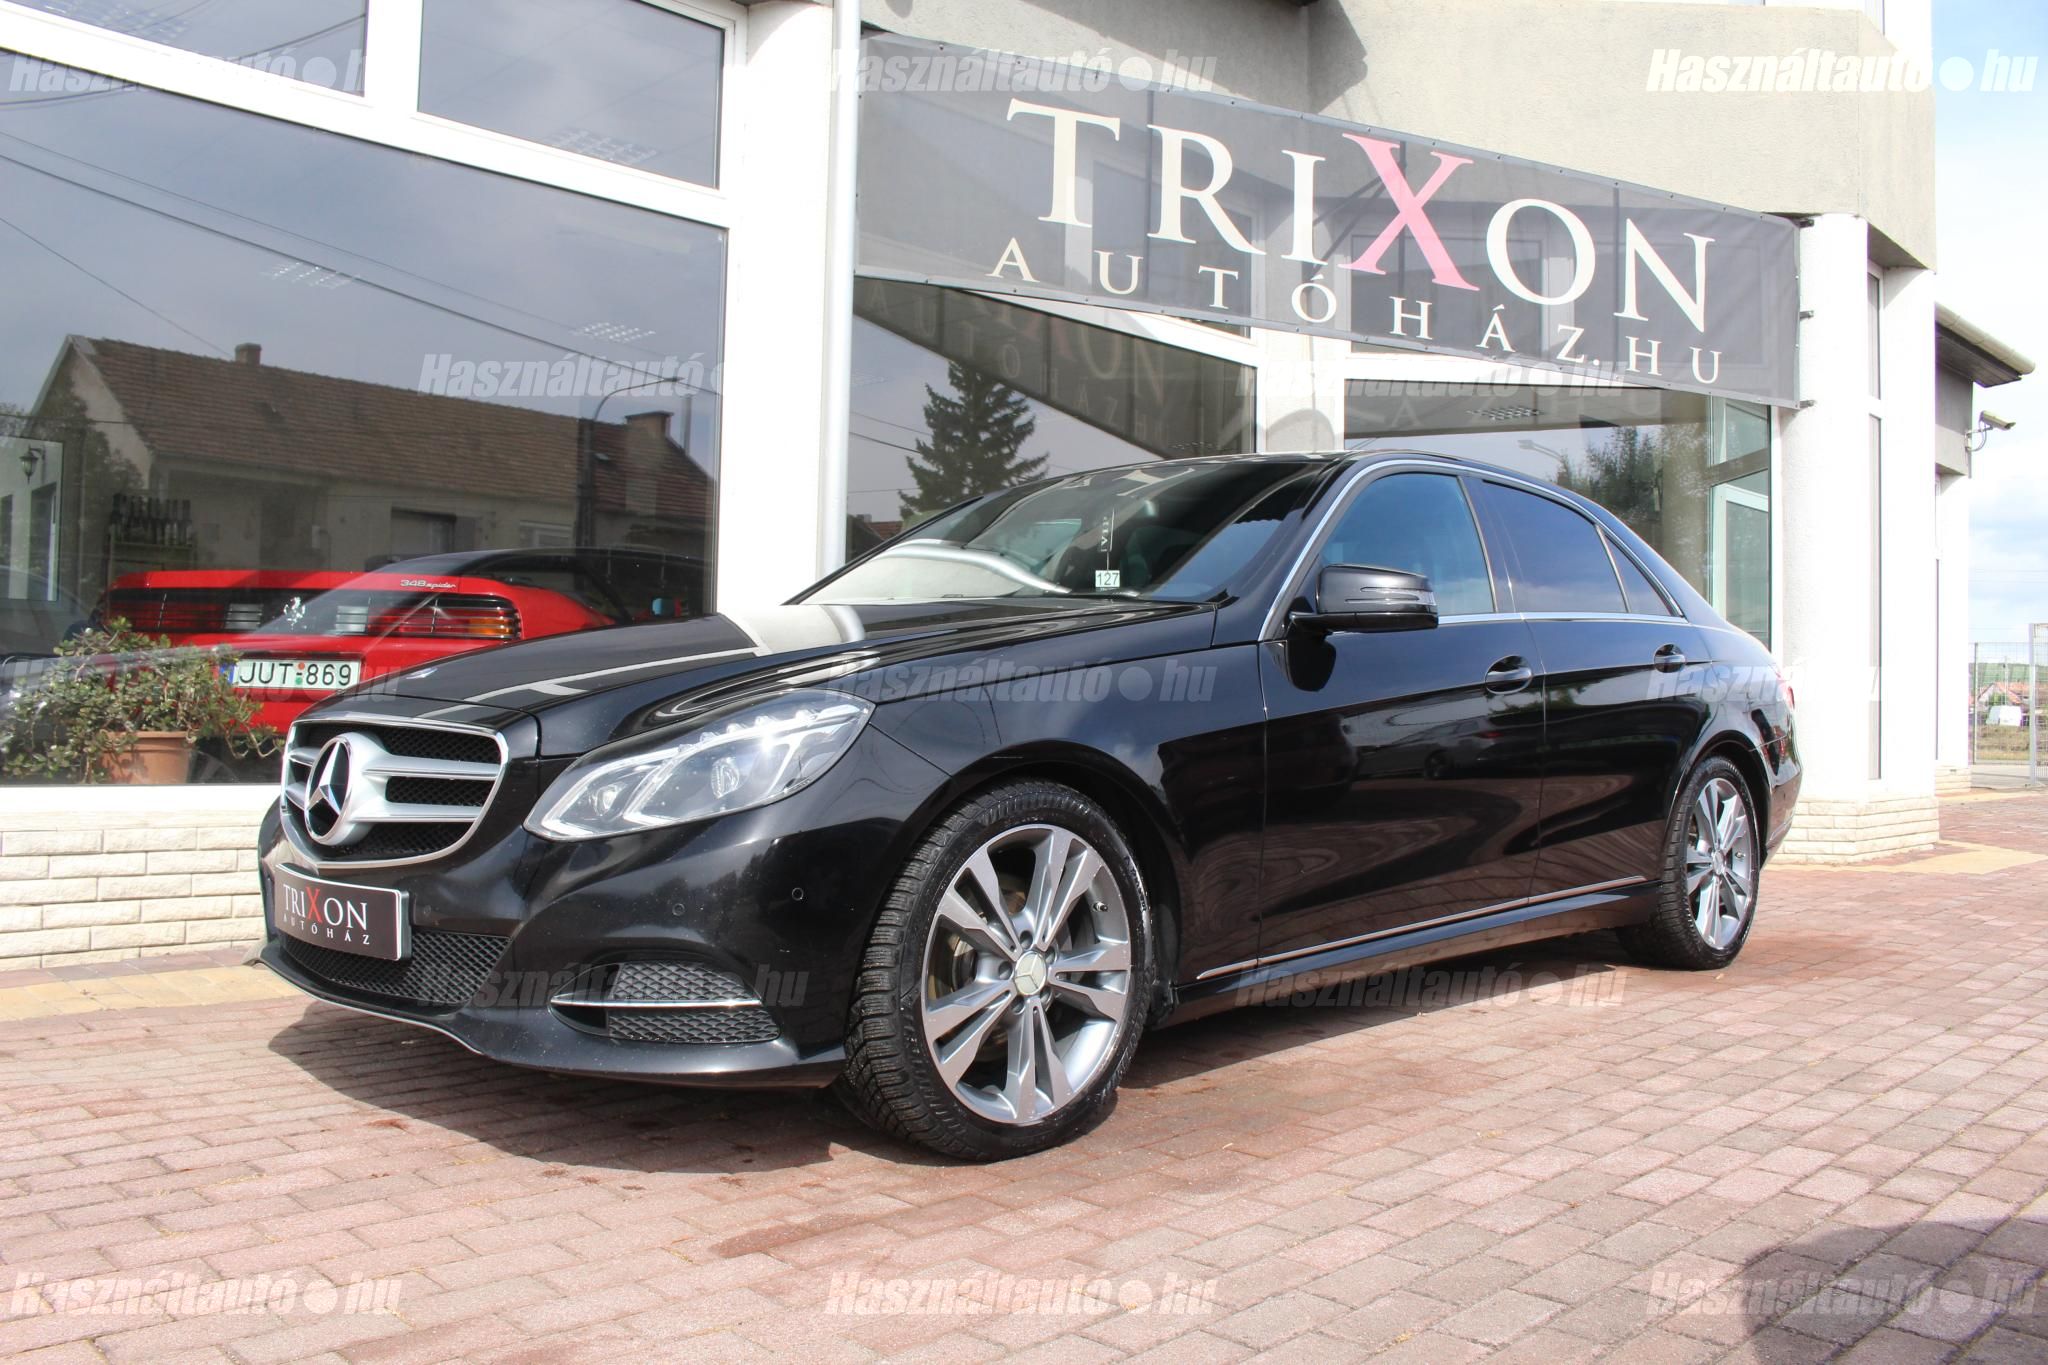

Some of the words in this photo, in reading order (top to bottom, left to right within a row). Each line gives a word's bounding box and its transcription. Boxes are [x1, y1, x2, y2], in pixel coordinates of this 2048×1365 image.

[1007, 98, 1715, 333] TRIXON
[1097, 572, 1119, 586] 127
[283, 883, 367, 931] TRIXON
